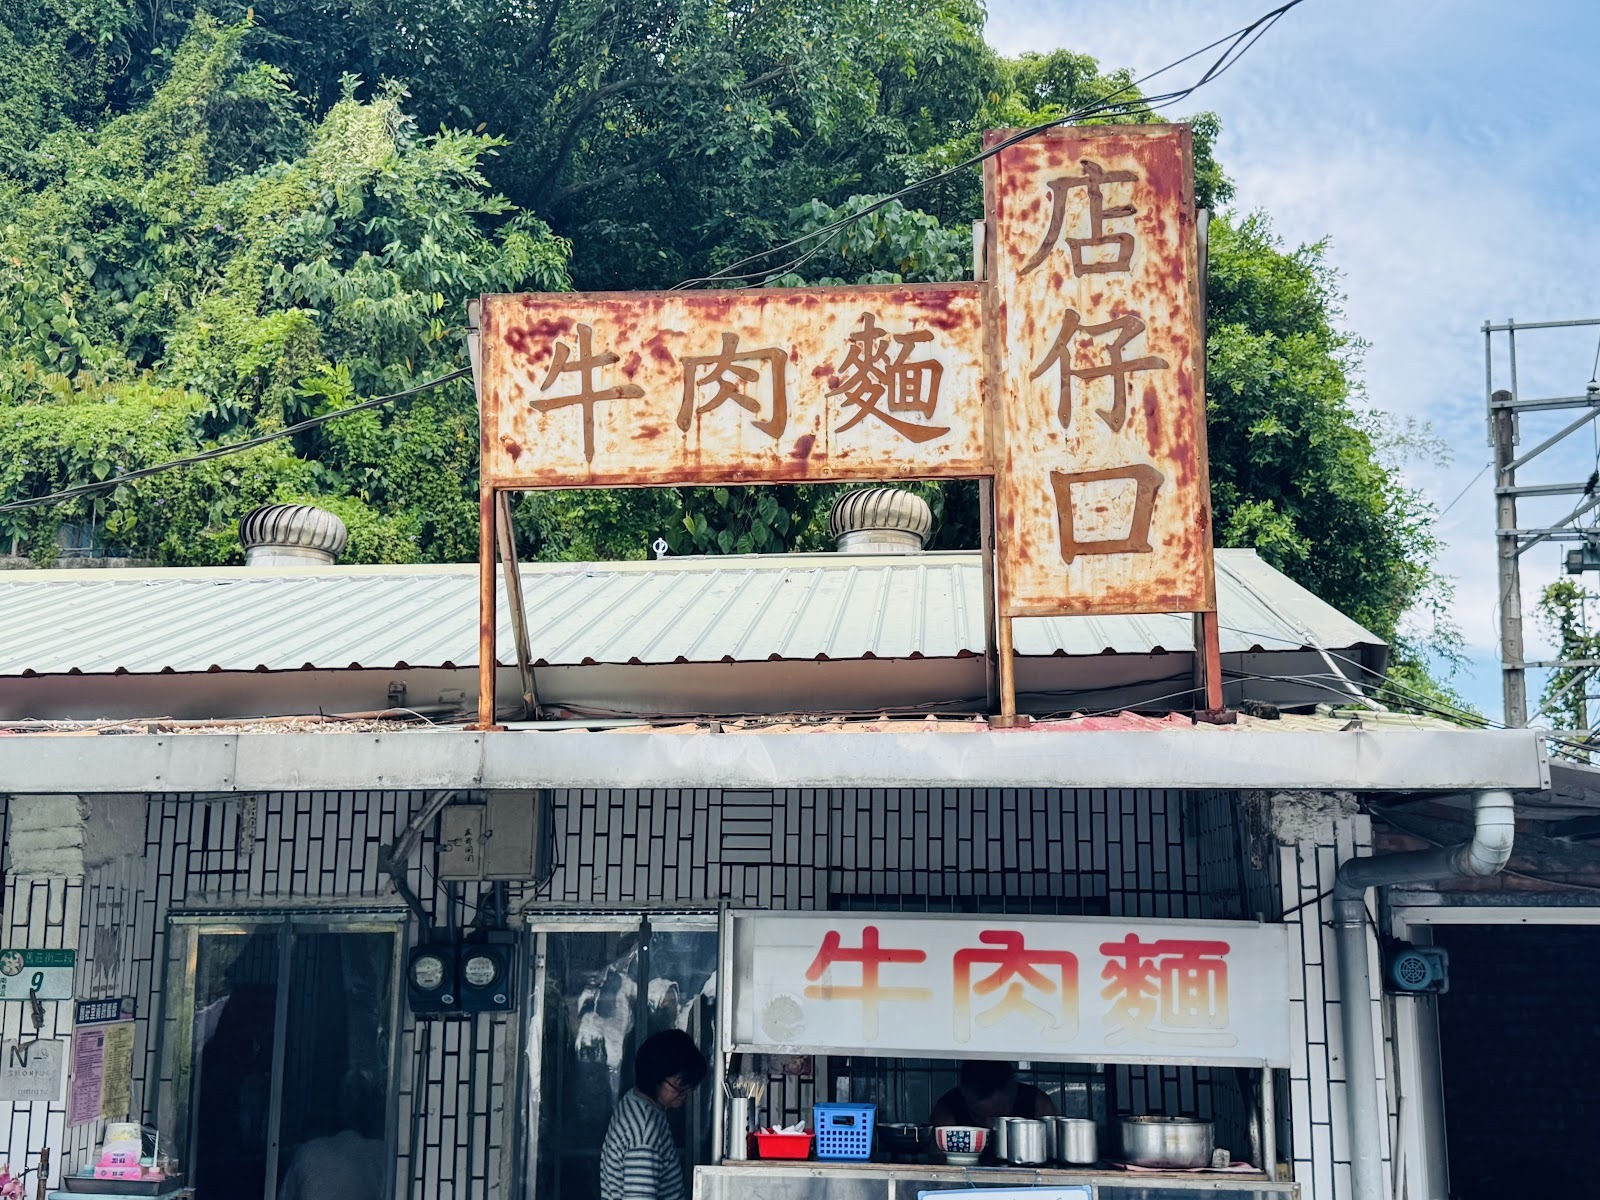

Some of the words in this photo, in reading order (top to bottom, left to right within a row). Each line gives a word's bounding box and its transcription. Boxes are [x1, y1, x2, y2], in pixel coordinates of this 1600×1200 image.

[528, 311, 951, 464] 牛肉麵
[1018, 159, 1169, 566] 店仔口
[31, 971, 44, 993] 9
[803, 925, 1239, 1049] 牛肉麵
